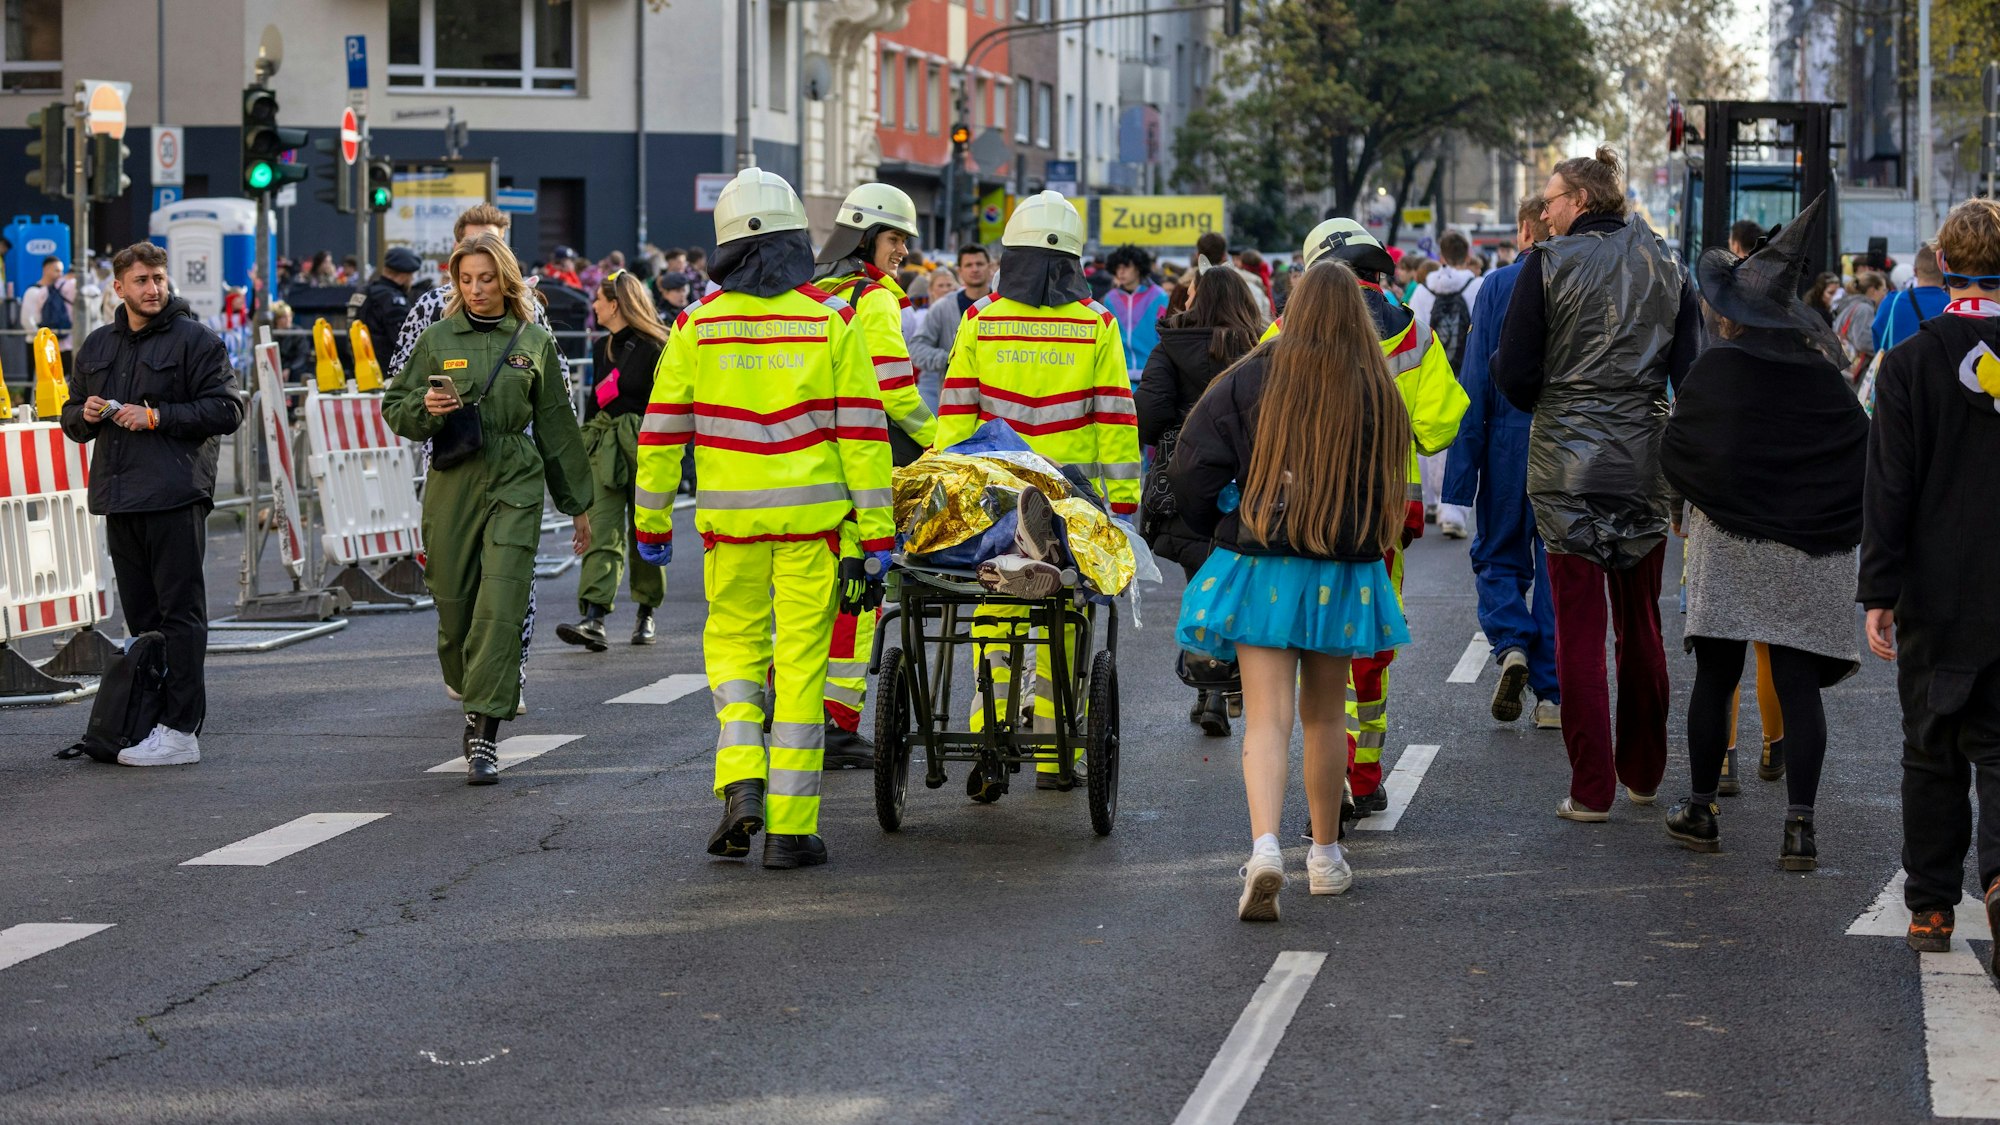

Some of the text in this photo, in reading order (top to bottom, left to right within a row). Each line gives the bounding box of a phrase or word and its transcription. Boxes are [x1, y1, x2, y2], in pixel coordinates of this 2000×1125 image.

[1112, 208, 1212, 234] Zugang
[697, 321, 827, 338] RETTUNGSDIENST
[978, 321, 1096, 338] RETTUNGSDIENST
[445, 361, 454, 369] TOP
[719, 350, 804, 370] STADT KÖLN
[996, 348, 1075, 366] STADT KÖLN
